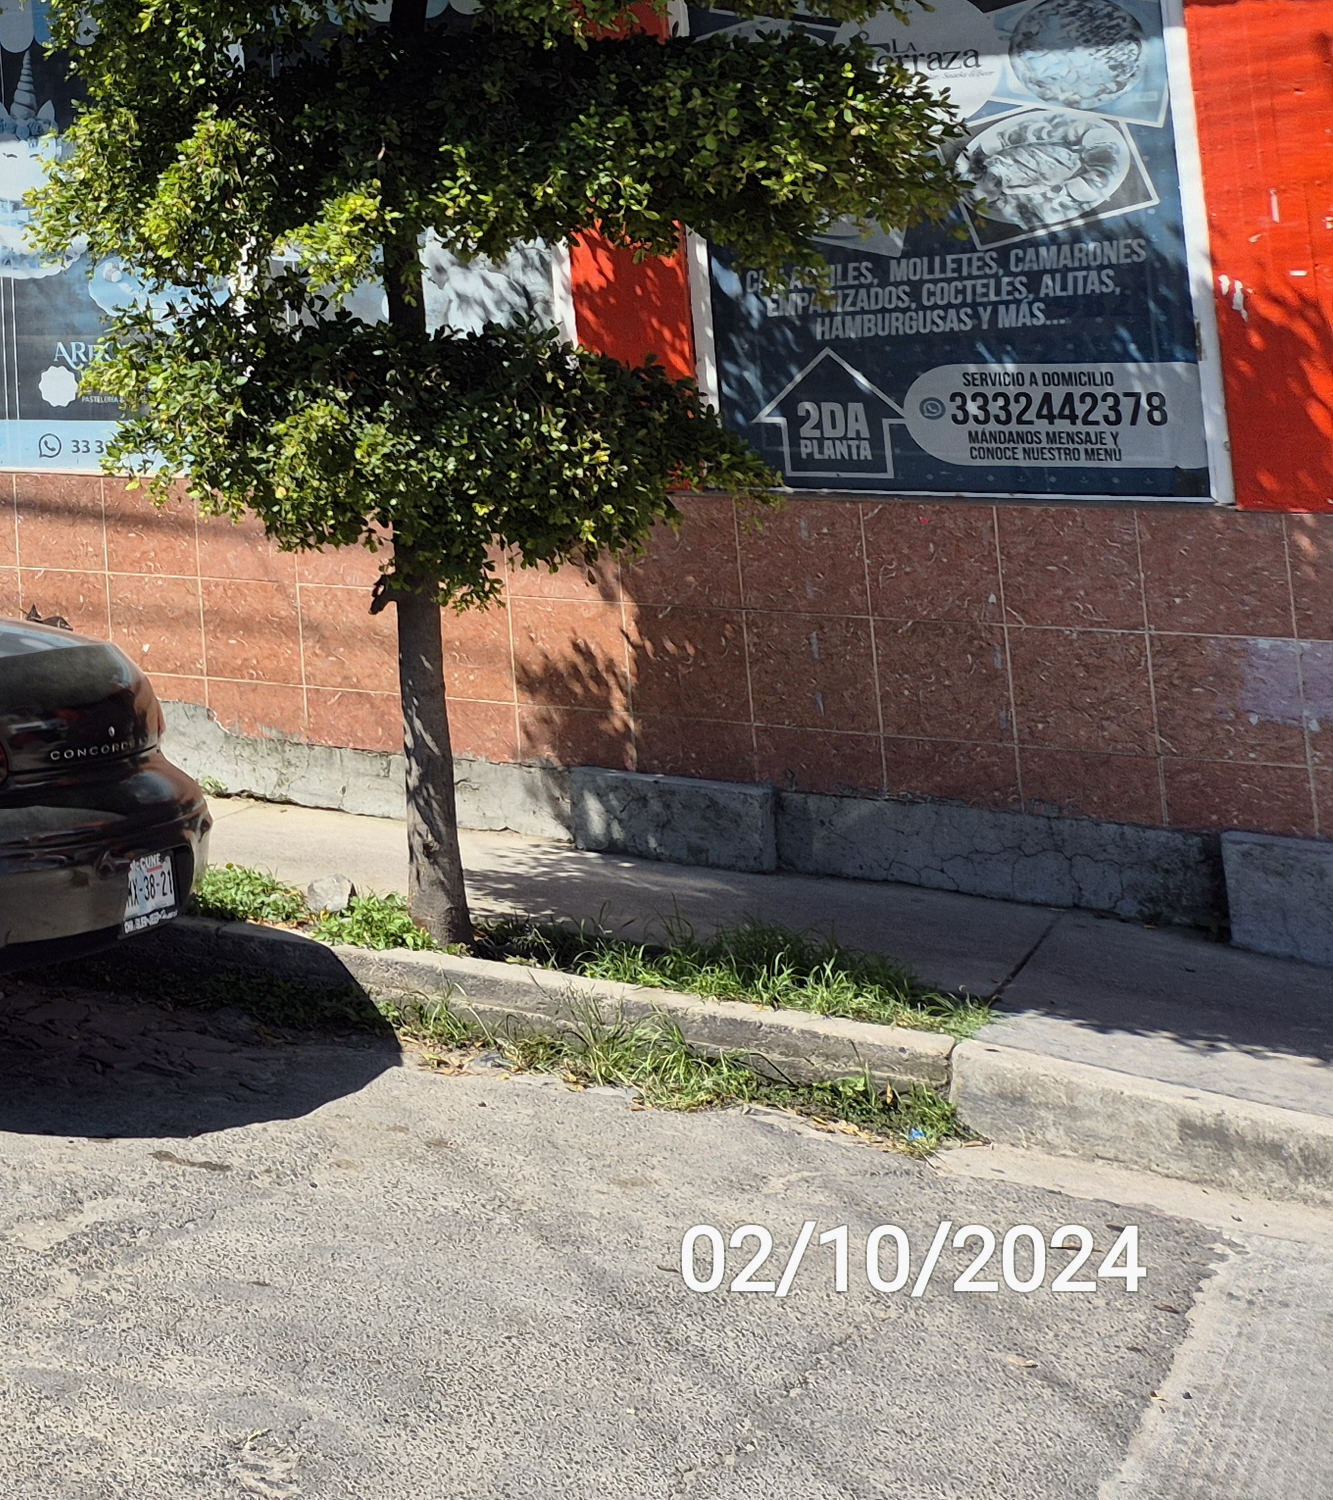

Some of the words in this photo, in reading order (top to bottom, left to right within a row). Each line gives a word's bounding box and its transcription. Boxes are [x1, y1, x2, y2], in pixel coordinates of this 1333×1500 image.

[889, 251, 1004, 282] MOLLETES,
[1009, 238, 1147, 272] CAMARONES
[765, 286, 916, 318] EMPAIZADOS,
[922, 276, 1034, 306] COCTELES,
[1039, 269, 1121, 298] ALITAS,
[816, 307, 973, 340] HAMBURGUSAS
[977, 305, 993, 329] Y
[962, 371, 1023, 387] SERVICIO
[1027, 371, 1038, 386] A
[1042, 371, 1115, 387] DOMICILIO
[797, 401, 871, 439] 2DA
[949, 391, 1169, 427] 3332442378
[71, 440, 91, 453] 33
[799, 439, 873, 461] PLANTA
[967, 428, 1044, 445] MÁNDANOS
[1045, 430, 1107, 446] MENSAJE
[1108, 431, 1120, 446] Y
[969, 446, 1020, 461] CONOCE
[1022, 446, 1081, 461] NUESTRO
